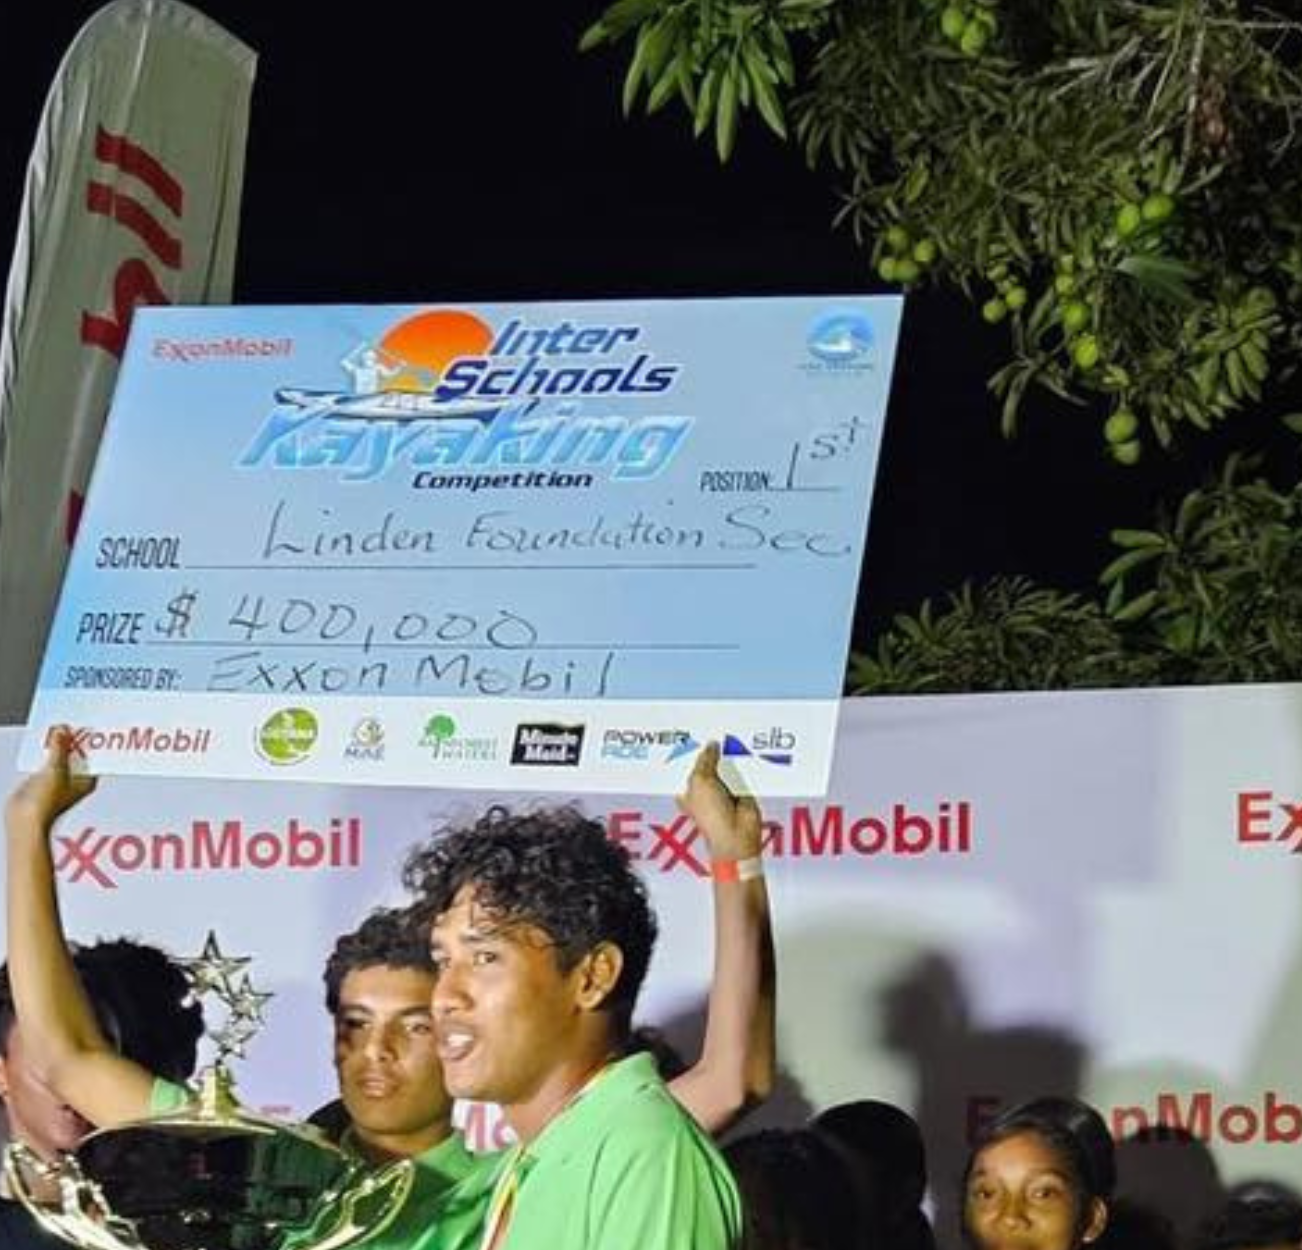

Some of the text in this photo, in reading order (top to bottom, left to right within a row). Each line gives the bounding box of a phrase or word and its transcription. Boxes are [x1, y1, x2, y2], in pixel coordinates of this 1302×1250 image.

[152, 337, 293, 363] ExxonMobil
[490, 319, 639, 356] Inter
[434, 354, 677, 402] Schools
[236, 399, 696, 482] Kayaking
[786, 414, 869, 491] 1st
[411, 470, 593, 492] Competition
[262, 499, 434, 559] Linden
[466, 500, 705, 552] Foundation
[96, 537, 181, 569] SCHOOL
[76, 611, 146, 644] PRIZE
[155, 588, 538, 653] $ 400,000
[64, 666, 152, 689] SPONSORED
[206, 650, 388, 692] Exxon
[520, 728, 579, 745] Minute
[603, 729, 691, 745] POWER
[753, 727, 797, 750] slb
